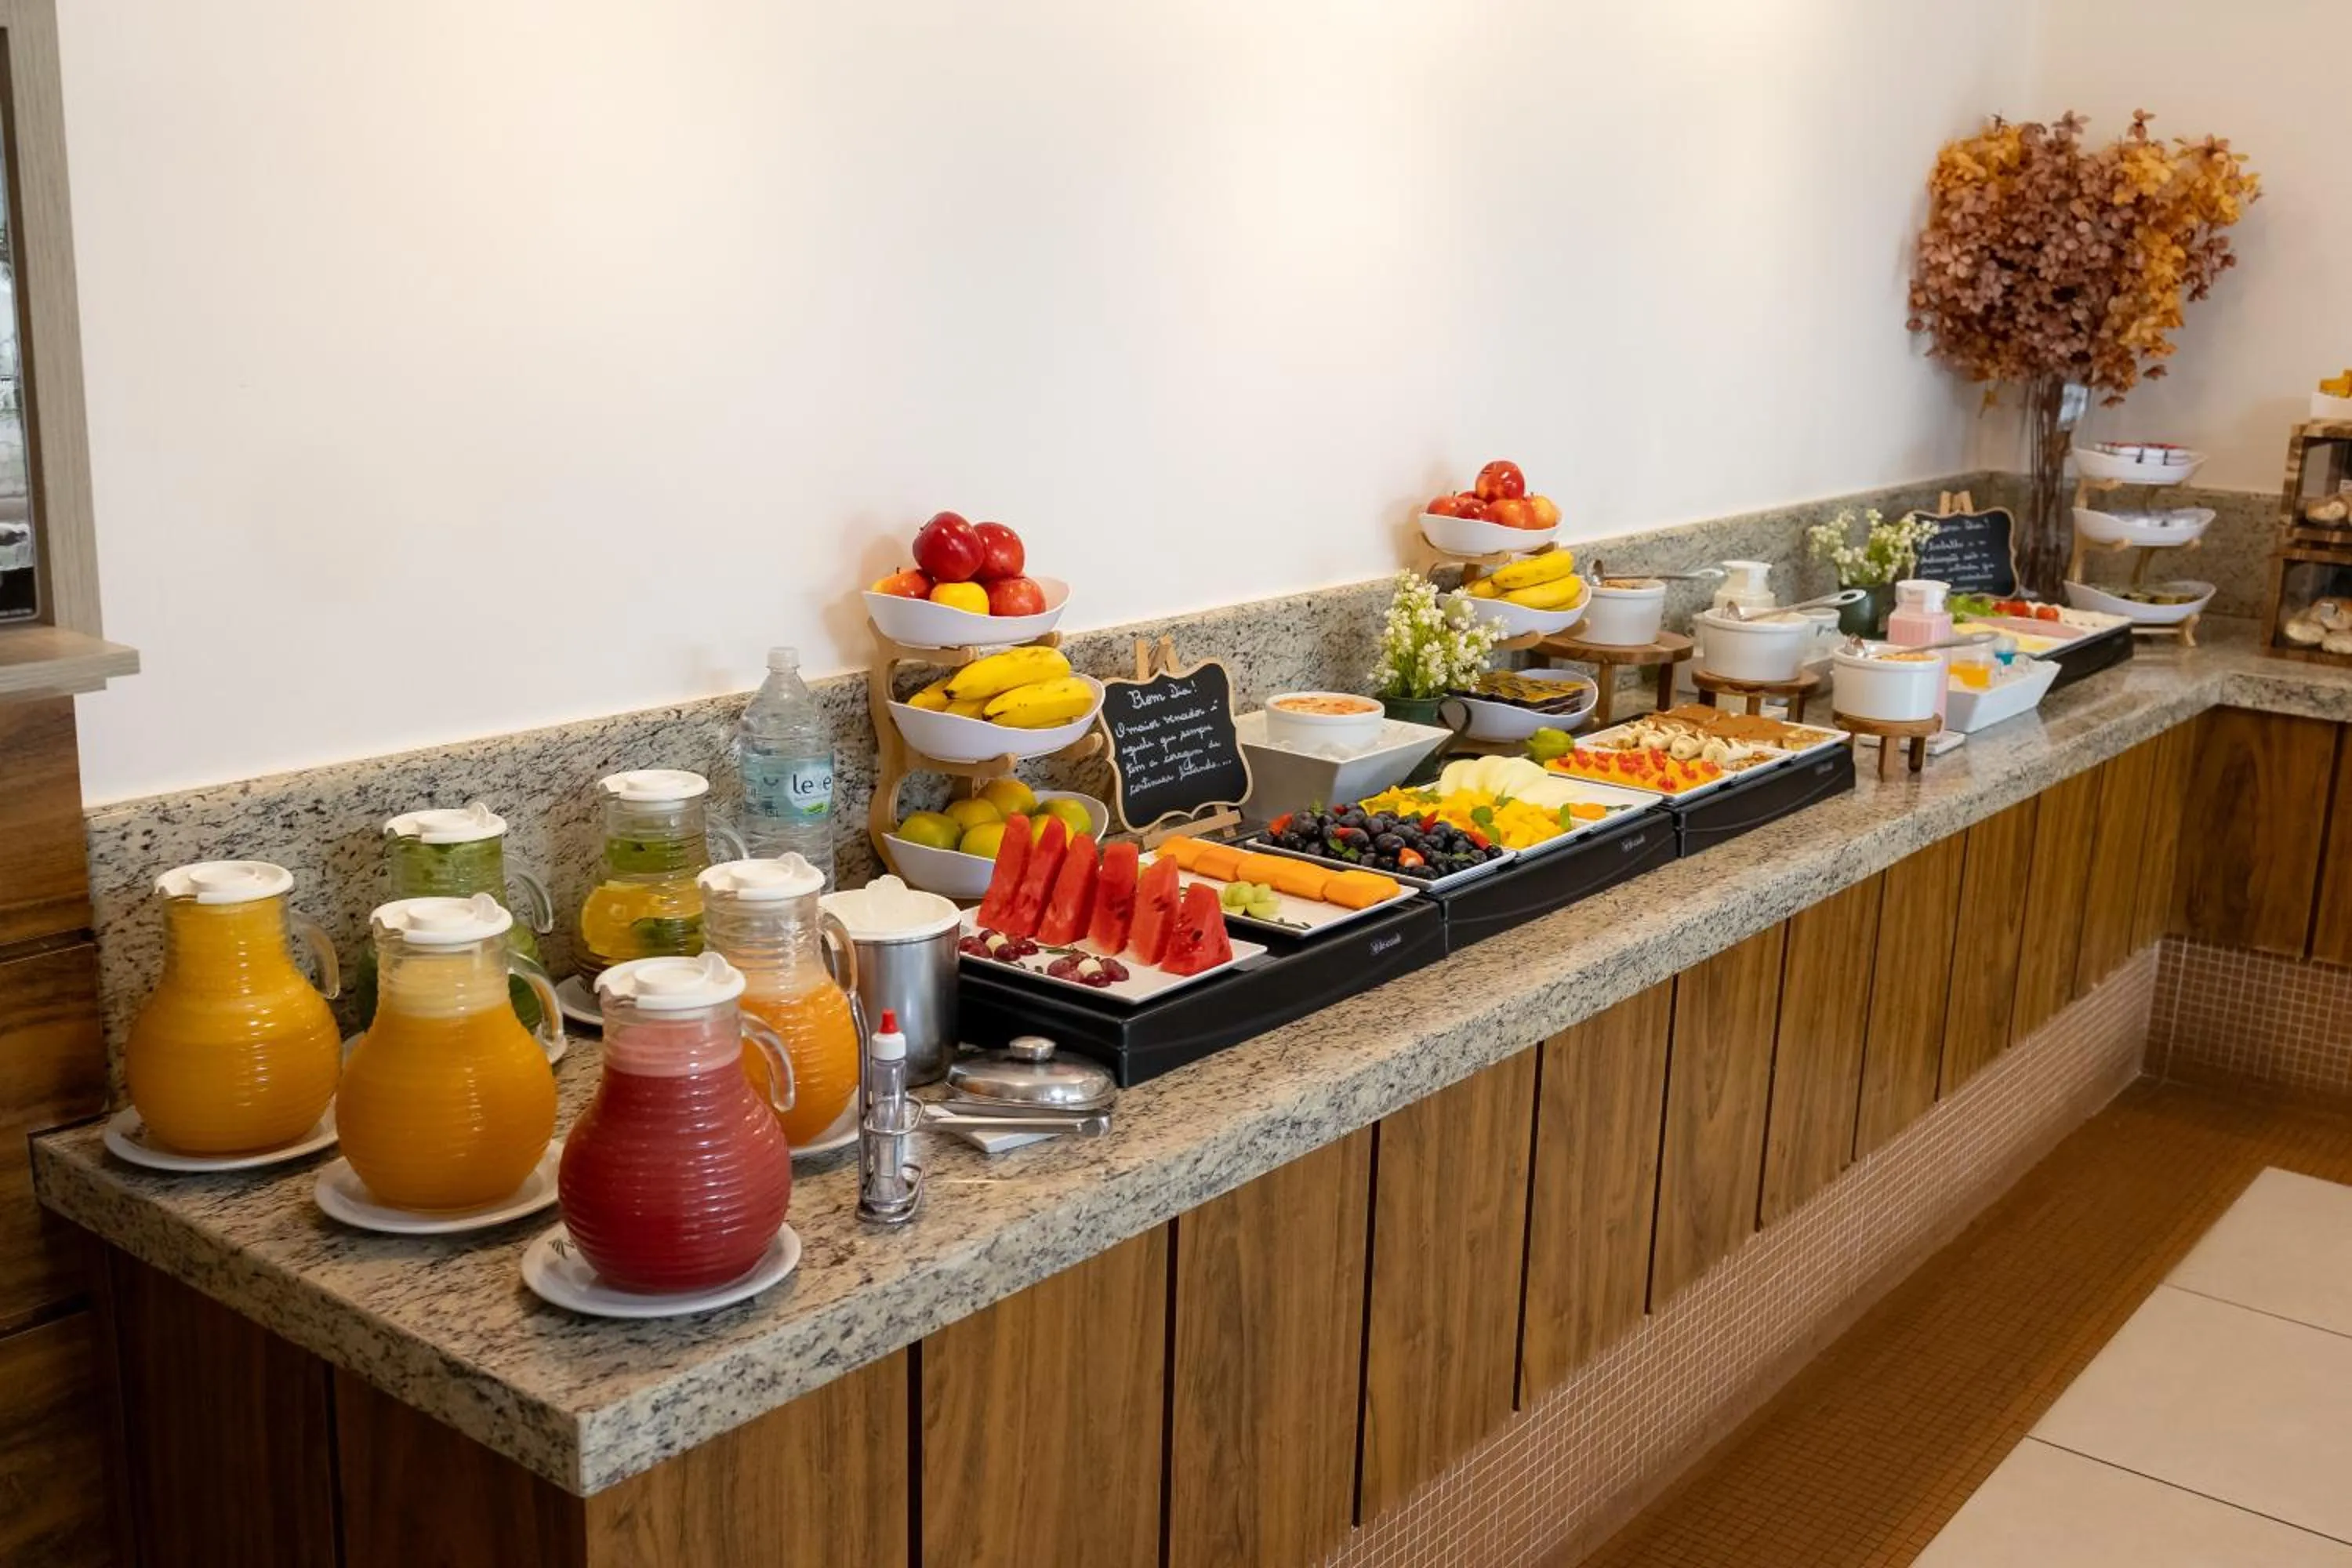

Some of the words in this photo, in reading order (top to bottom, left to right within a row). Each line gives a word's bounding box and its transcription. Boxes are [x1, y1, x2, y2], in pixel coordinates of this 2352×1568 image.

[1127, 689, 1166, 710] Bom
[1168, 681, 1197, 699] Dia!
[1126, 719, 1161, 735] maior
[1160, 735, 1176, 753] que
